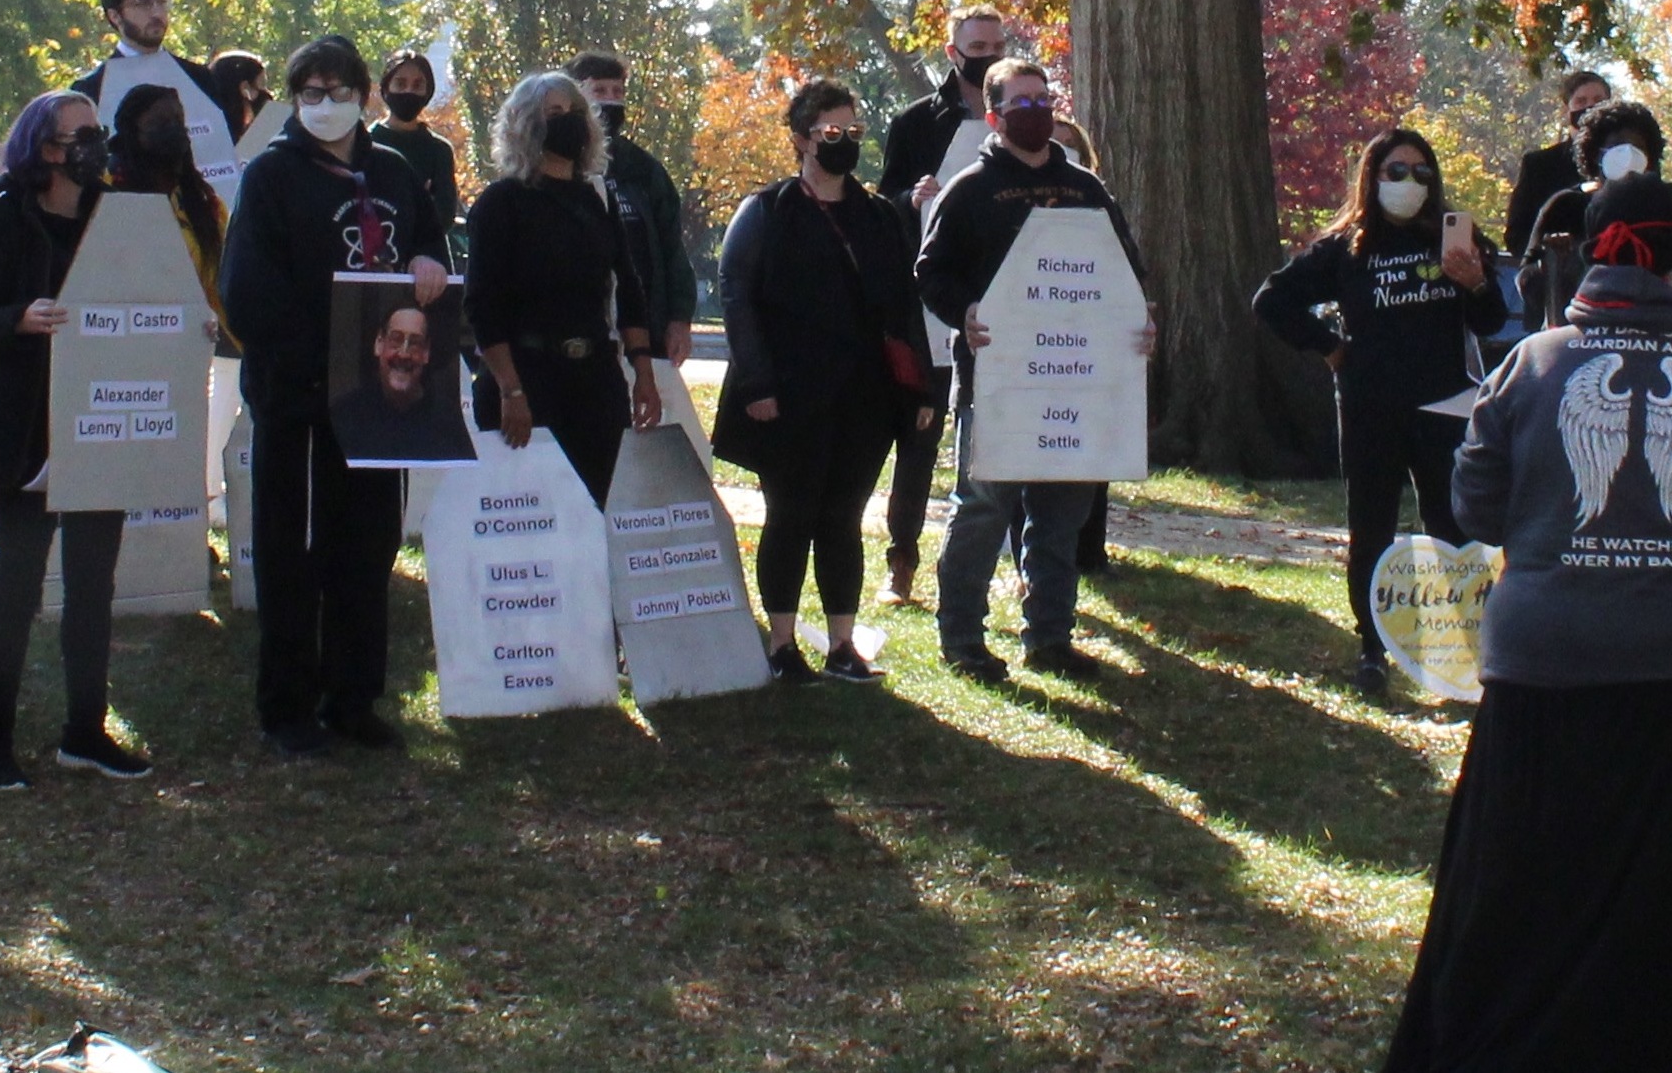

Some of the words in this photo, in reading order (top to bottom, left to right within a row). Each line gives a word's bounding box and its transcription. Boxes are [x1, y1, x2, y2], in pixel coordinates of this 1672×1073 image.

[202, 166, 234, 178] dows
[1037, 259, 1095, 274] Richard
[1376, 270, 1407, 285] The
[1027, 287, 1044, 300] M.
[1049, 287, 1101, 303] Rogers
[1373, 282, 1456, 308] Numbers
[85, 313, 119, 333] Mary
[134, 312, 179, 327] Castro
[1036, 334, 1087, 347] Debbie
[1568, 338, 1658, 352] GUARDIAN
[1028, 362, 1093, 375] Schaefer
[93, 388, 165, 402] Alexander
[1042, 408, 1079, 423] Jody
[79, 421, 122, 438] Lenny
[136, 417, 174, 435] Lloyd
[1038, 436, 1080, 448] Settle
[480, 493, 539, 511] Bonnie
[153, 507, 198, 520] Kogan
[613, 514, 665, 530] Veronica
[672, 509, 710, 522] Flores
[474, 517, 554, 535] O'Connor
[1571, 536, 1598, 549] HE
[629, 555, 659, 570] Elida
[663, 548, 717, 565] Gonzalez
[1560, 553, 1609, 567] OVER
[1615, 555, 1643, 567] MY
[490, 567, 527, 581] Ulus
[534, 565, 548, 579] L.
[1387, 559, 1499, 578] Washington
[486, 594, 556, 611] Crowder
[636, 599, 679, 616] Johnny
[687, 588, 731, 607] Pobicki
[1376, 582, 1463, 613] Yellow
[1414, 617, 1481, 631] Memor
[494, 644, 554, 660] Carlton
[504, 675, 554, 689] Eaves
